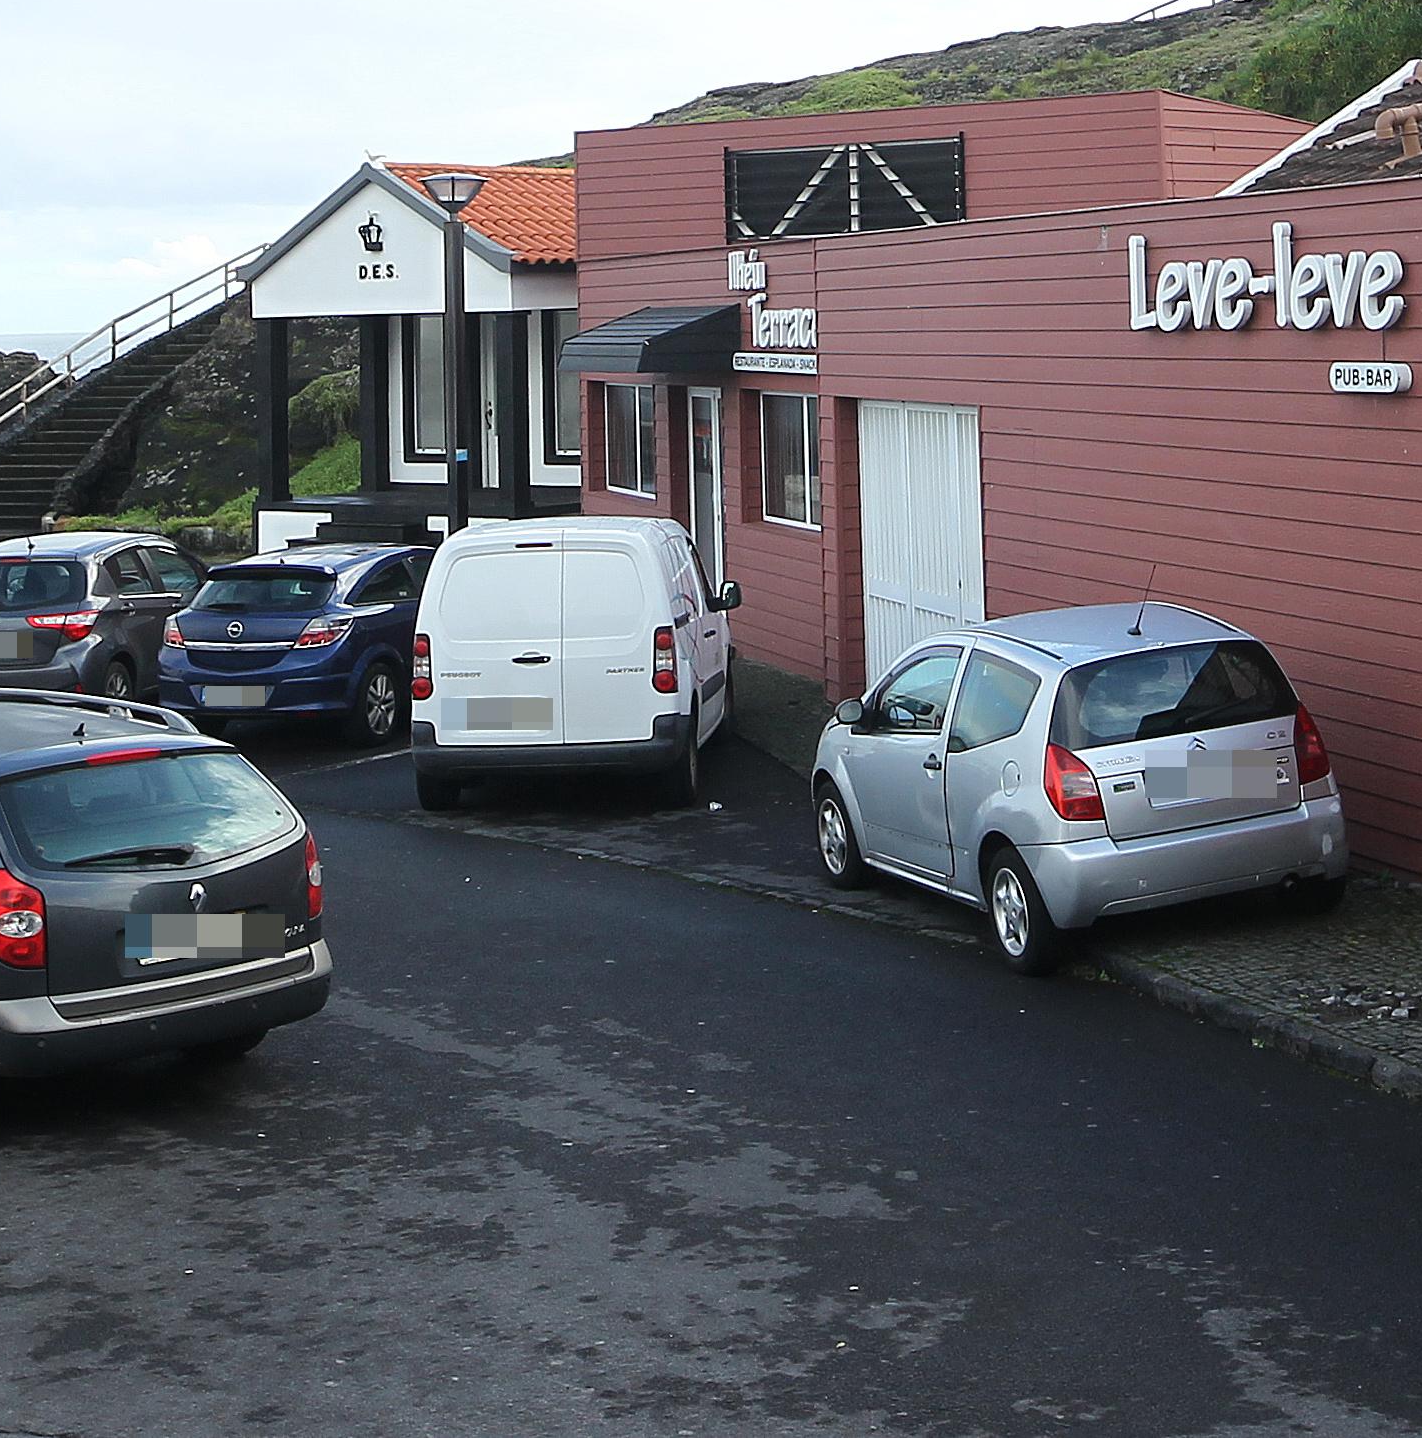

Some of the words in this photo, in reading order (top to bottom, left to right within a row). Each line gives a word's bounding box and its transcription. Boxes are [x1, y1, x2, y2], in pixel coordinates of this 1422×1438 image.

[358, 264, 399, 280] D.E.S.
[1128, 221, 1404, 331] Leve-leve
[1335, 368, 1392, 386] PUB-BAR
[1266, 730, 1287, 740] C2
